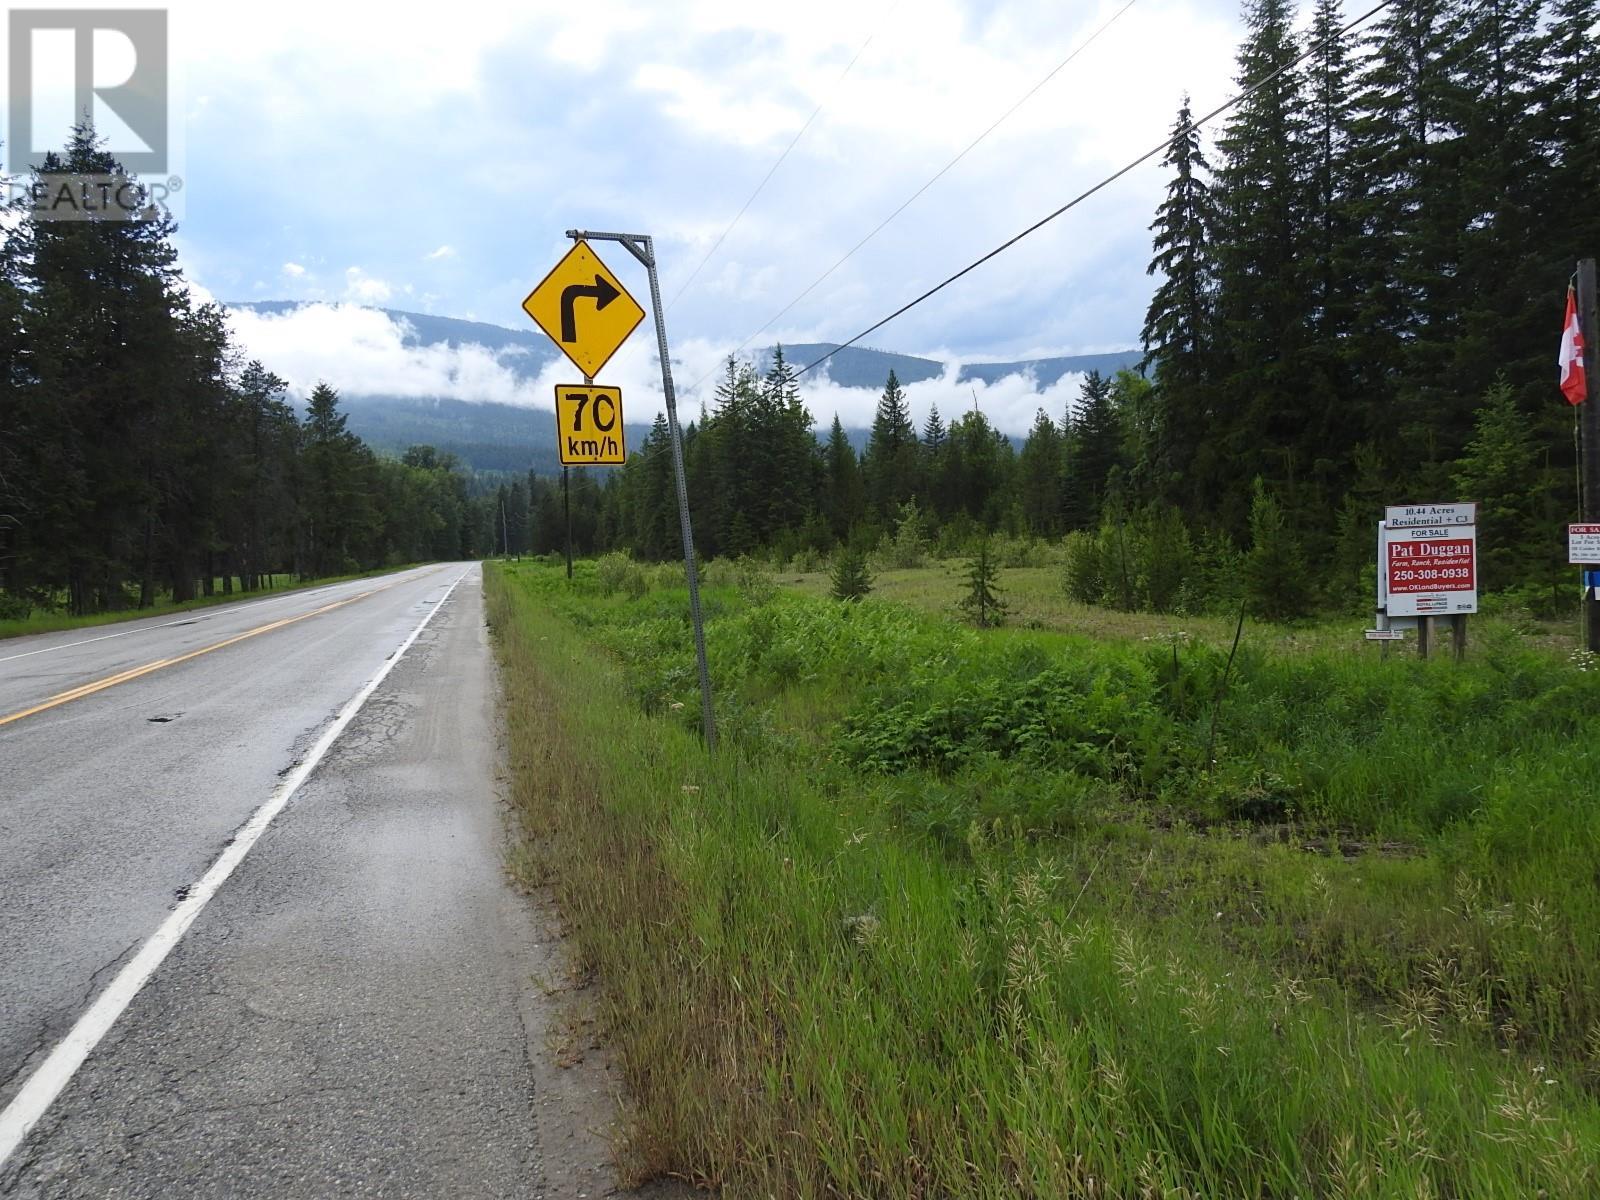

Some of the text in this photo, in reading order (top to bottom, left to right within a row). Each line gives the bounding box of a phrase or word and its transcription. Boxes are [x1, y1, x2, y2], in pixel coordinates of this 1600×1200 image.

[565, 393, 616, 432] 70
[567, 436, 618, 458] km/h
[1430, 507, 1455, 515] Acres
[1392, 516, 1442, 526] Residential
[1392, 543, 1470, 557] Pat Duggan
[1433, 557, 1470, 565] Residential
[1394, 568, 1469, 581] 250-308-0938
[1392, 583, 1471, 592] www.OKLandBuyers.com
